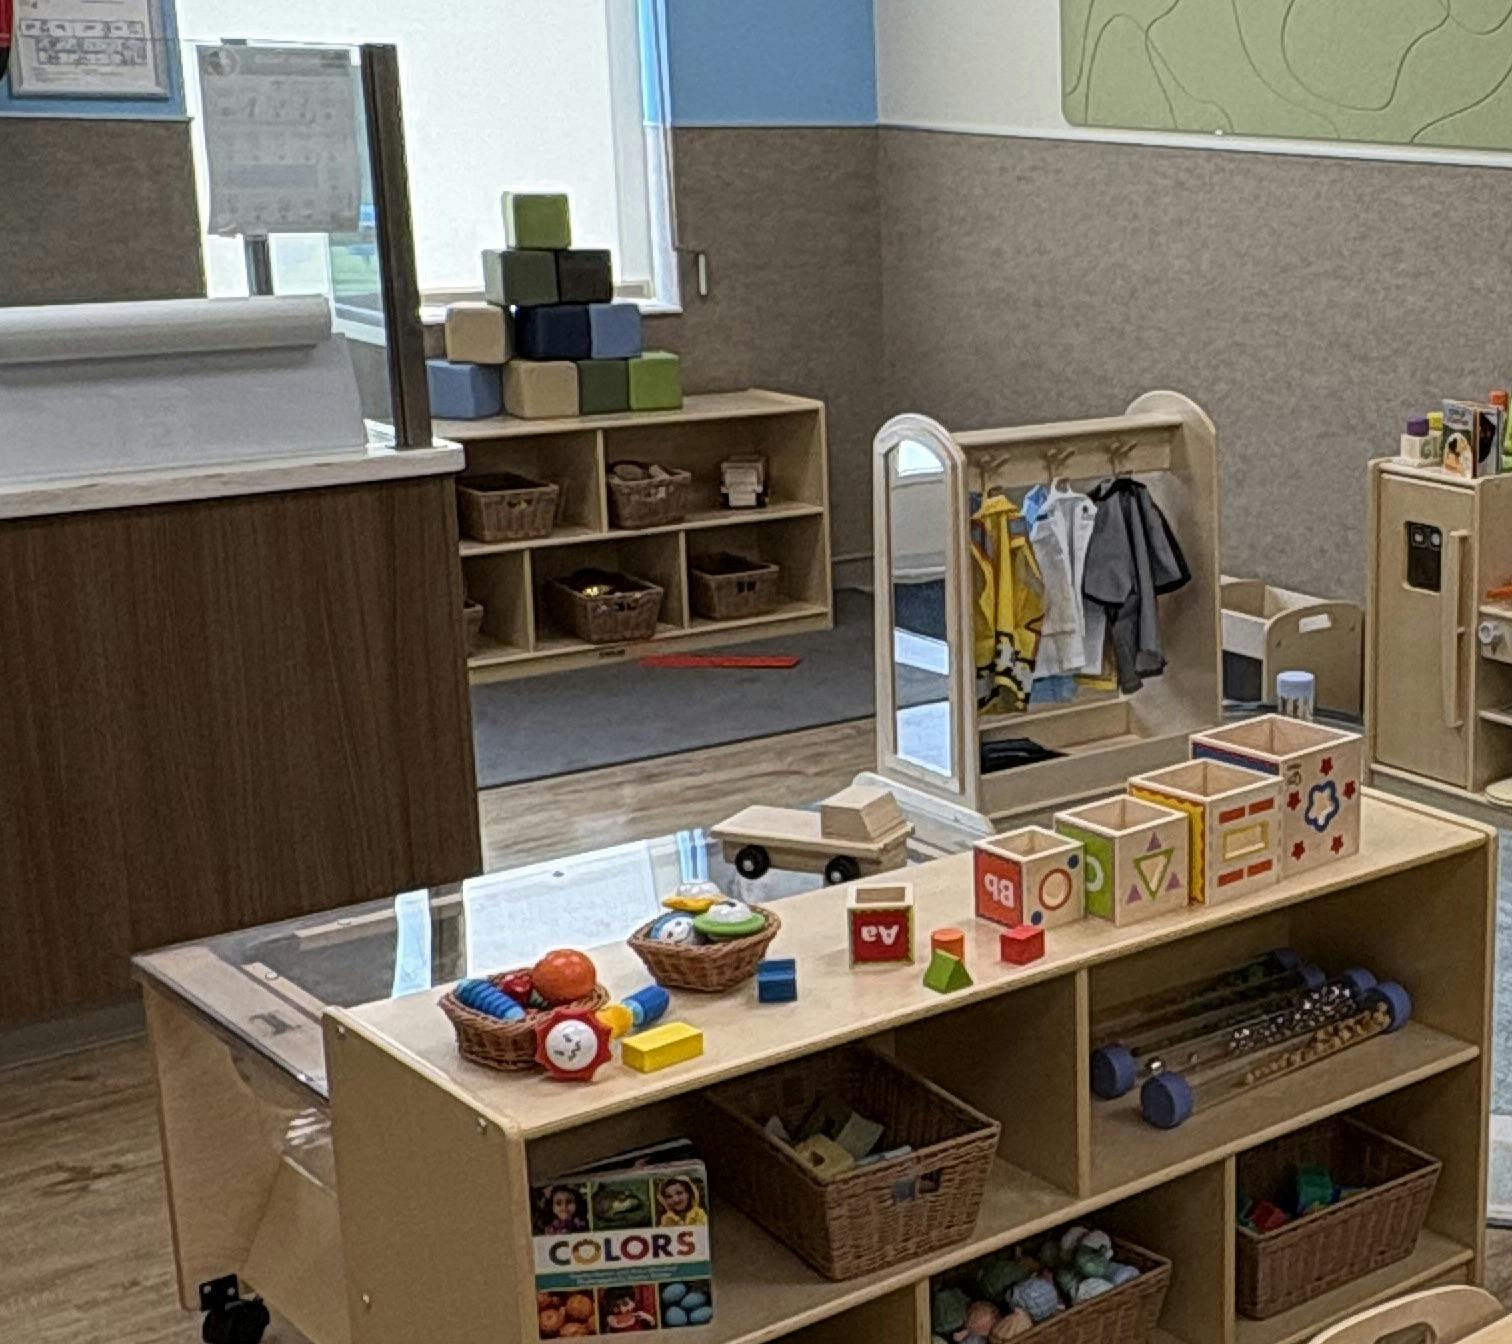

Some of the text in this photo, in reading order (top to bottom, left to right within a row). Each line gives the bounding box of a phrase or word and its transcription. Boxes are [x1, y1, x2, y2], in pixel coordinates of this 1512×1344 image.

[983, 872, 1015, 908] Bb
[860, 924, 900, 946] Aa
[548, 1230, 697, 1266] COLORS
